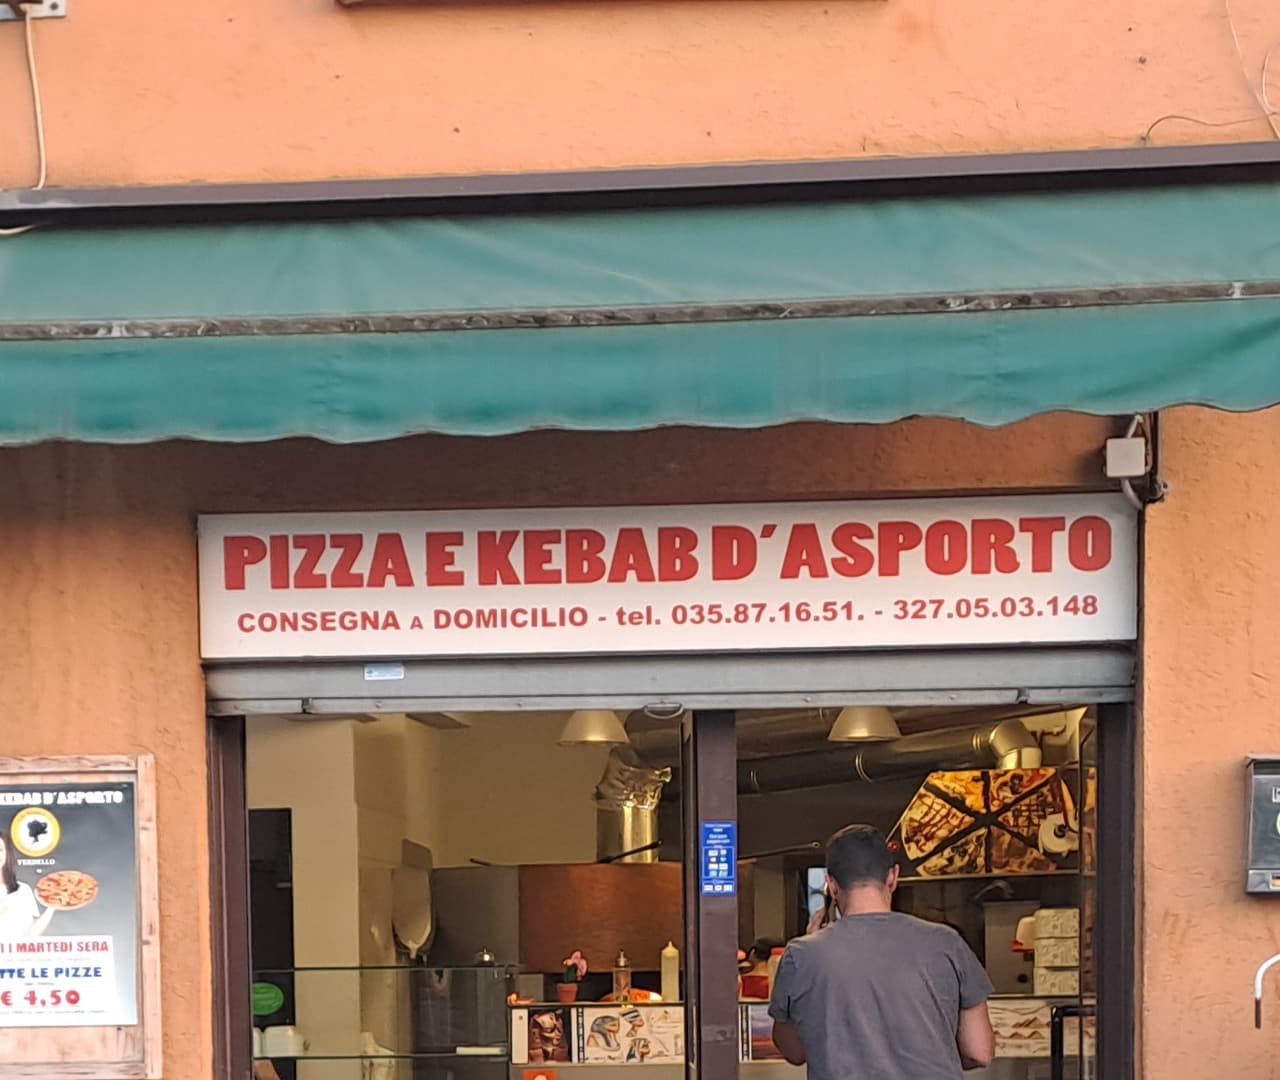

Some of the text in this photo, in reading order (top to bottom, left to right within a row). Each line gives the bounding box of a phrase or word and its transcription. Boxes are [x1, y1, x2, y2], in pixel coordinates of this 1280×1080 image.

[223, 516, 1112, 592] PIZZA E KEBAB D'ASPORTO
[238, 611, 401, 634] CONSEGNA
[410, 617, 424, 630] A
[434, 607, 590, 631] DOMICILIO
[616, 607, 661, 627] tel.
[671, 602, 866, 625] 035.87.16.51.
[893, 596, 1099, 621] 327.05.03.148
[76, 940, 109, 952] SERA
[31, 967, 49, 978] LE
[54, 966, 103, 978] PIZZE
[0, 989, 81, 1007] € 4,50
